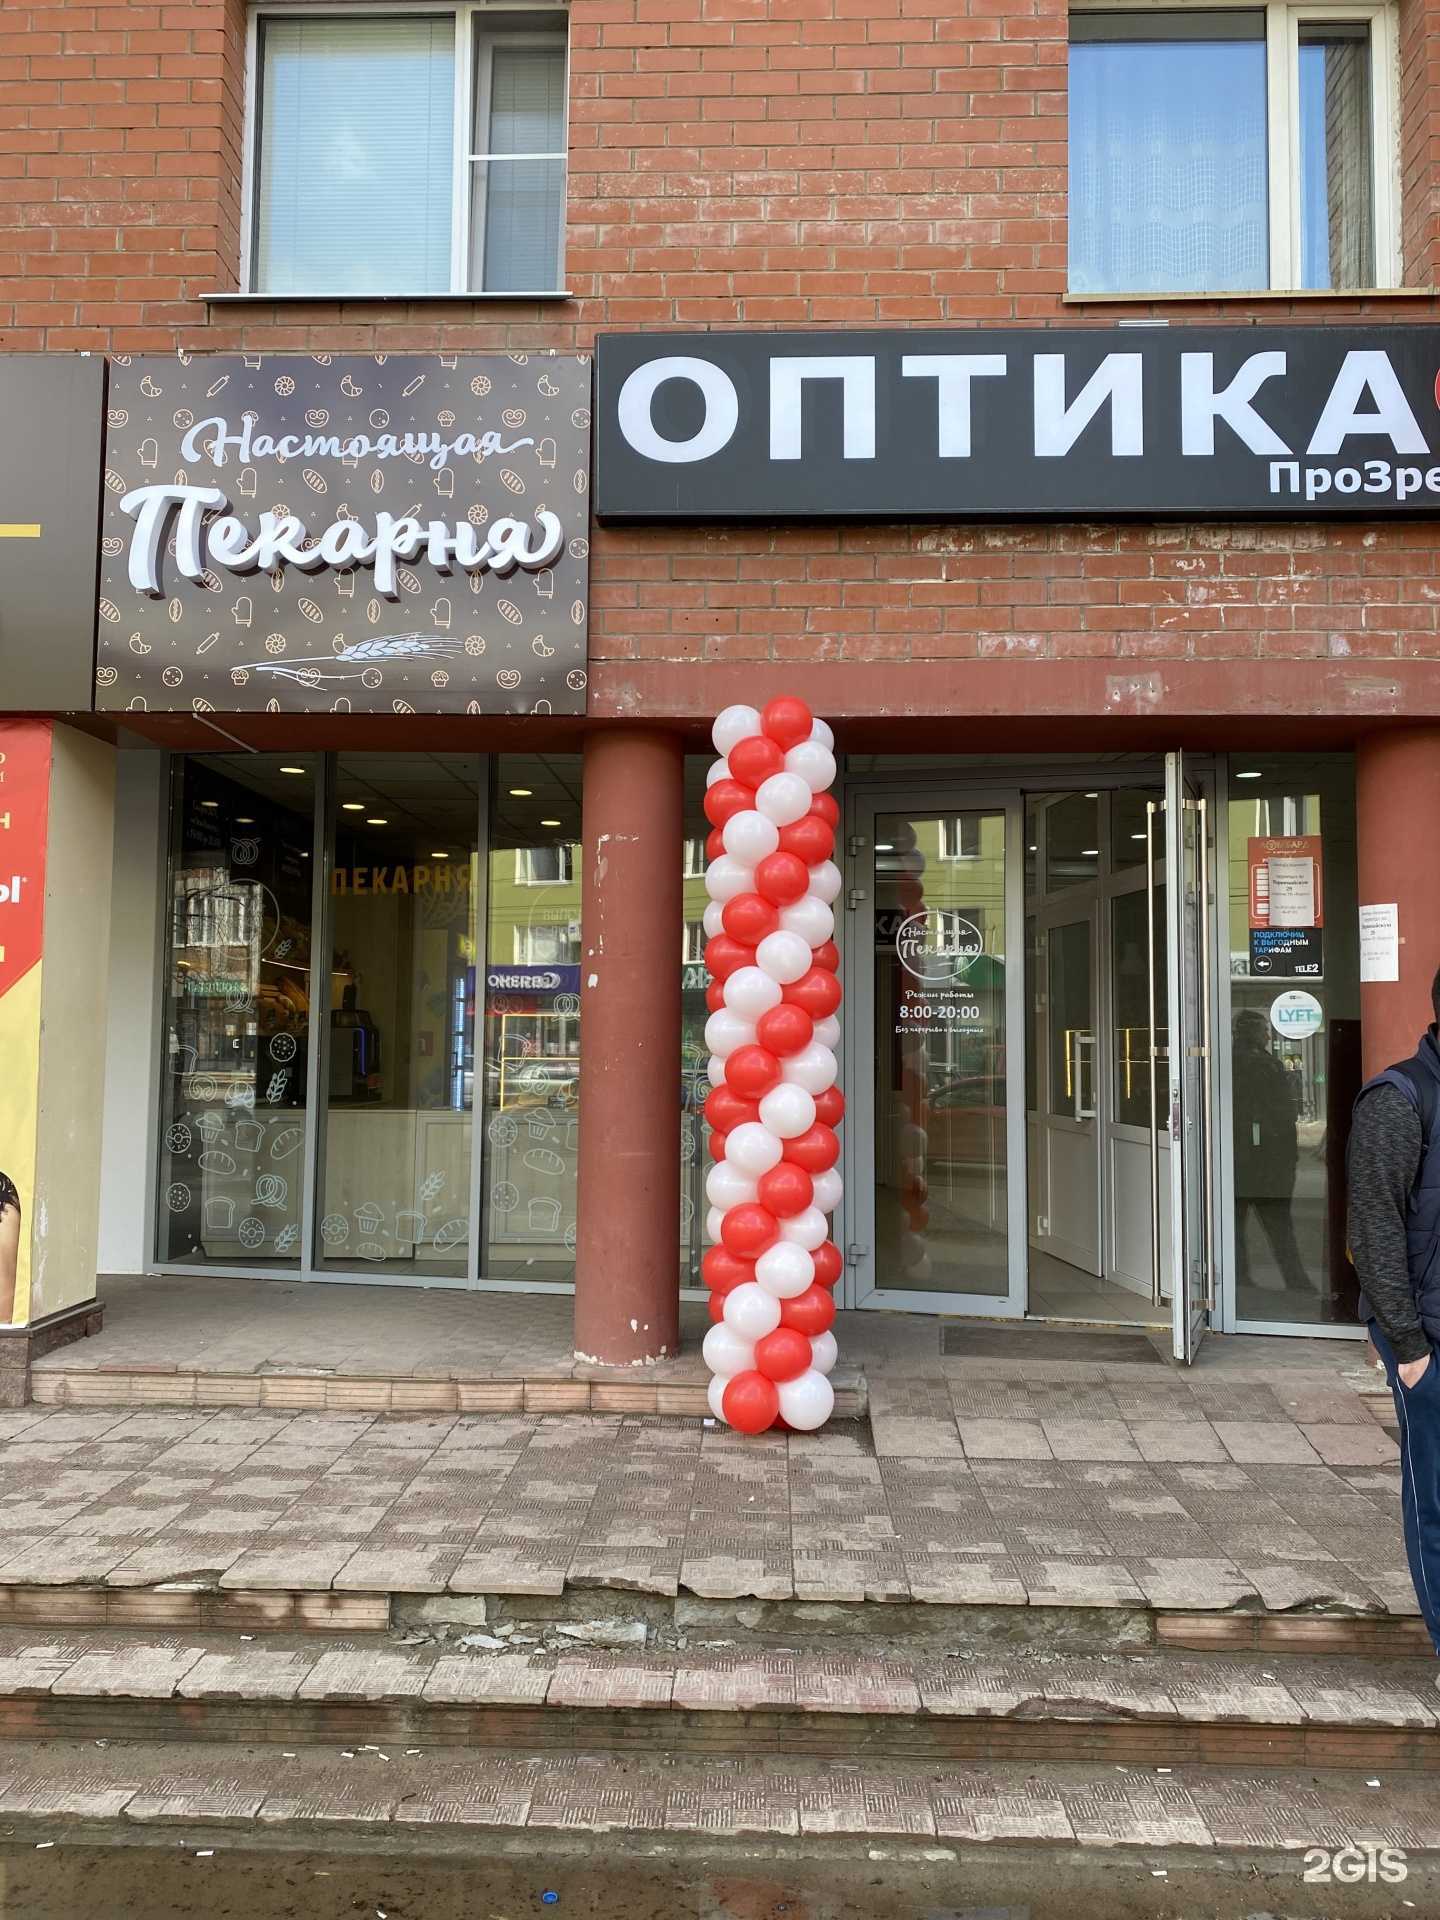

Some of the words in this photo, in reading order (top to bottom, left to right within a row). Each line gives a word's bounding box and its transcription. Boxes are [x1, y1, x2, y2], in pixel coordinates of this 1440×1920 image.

[617, 350, 1430, 465] ОПТИКА
[180, 415, 534, 470] Настоящая
[118, 484, 565, 601] Пекарня
[331, 864, 472, 897] ПЕКАРНЯ
[902, 926, 972, 939] Настщая
[1253, 931, 1304, 939] ПОДКЛЮЧИМ
[1295, 963, 1319, 973] TELE2
[899, 1005, 980, 1019] 8:00-20:00
[1278, 1008, 1313, 1022] LYFT
